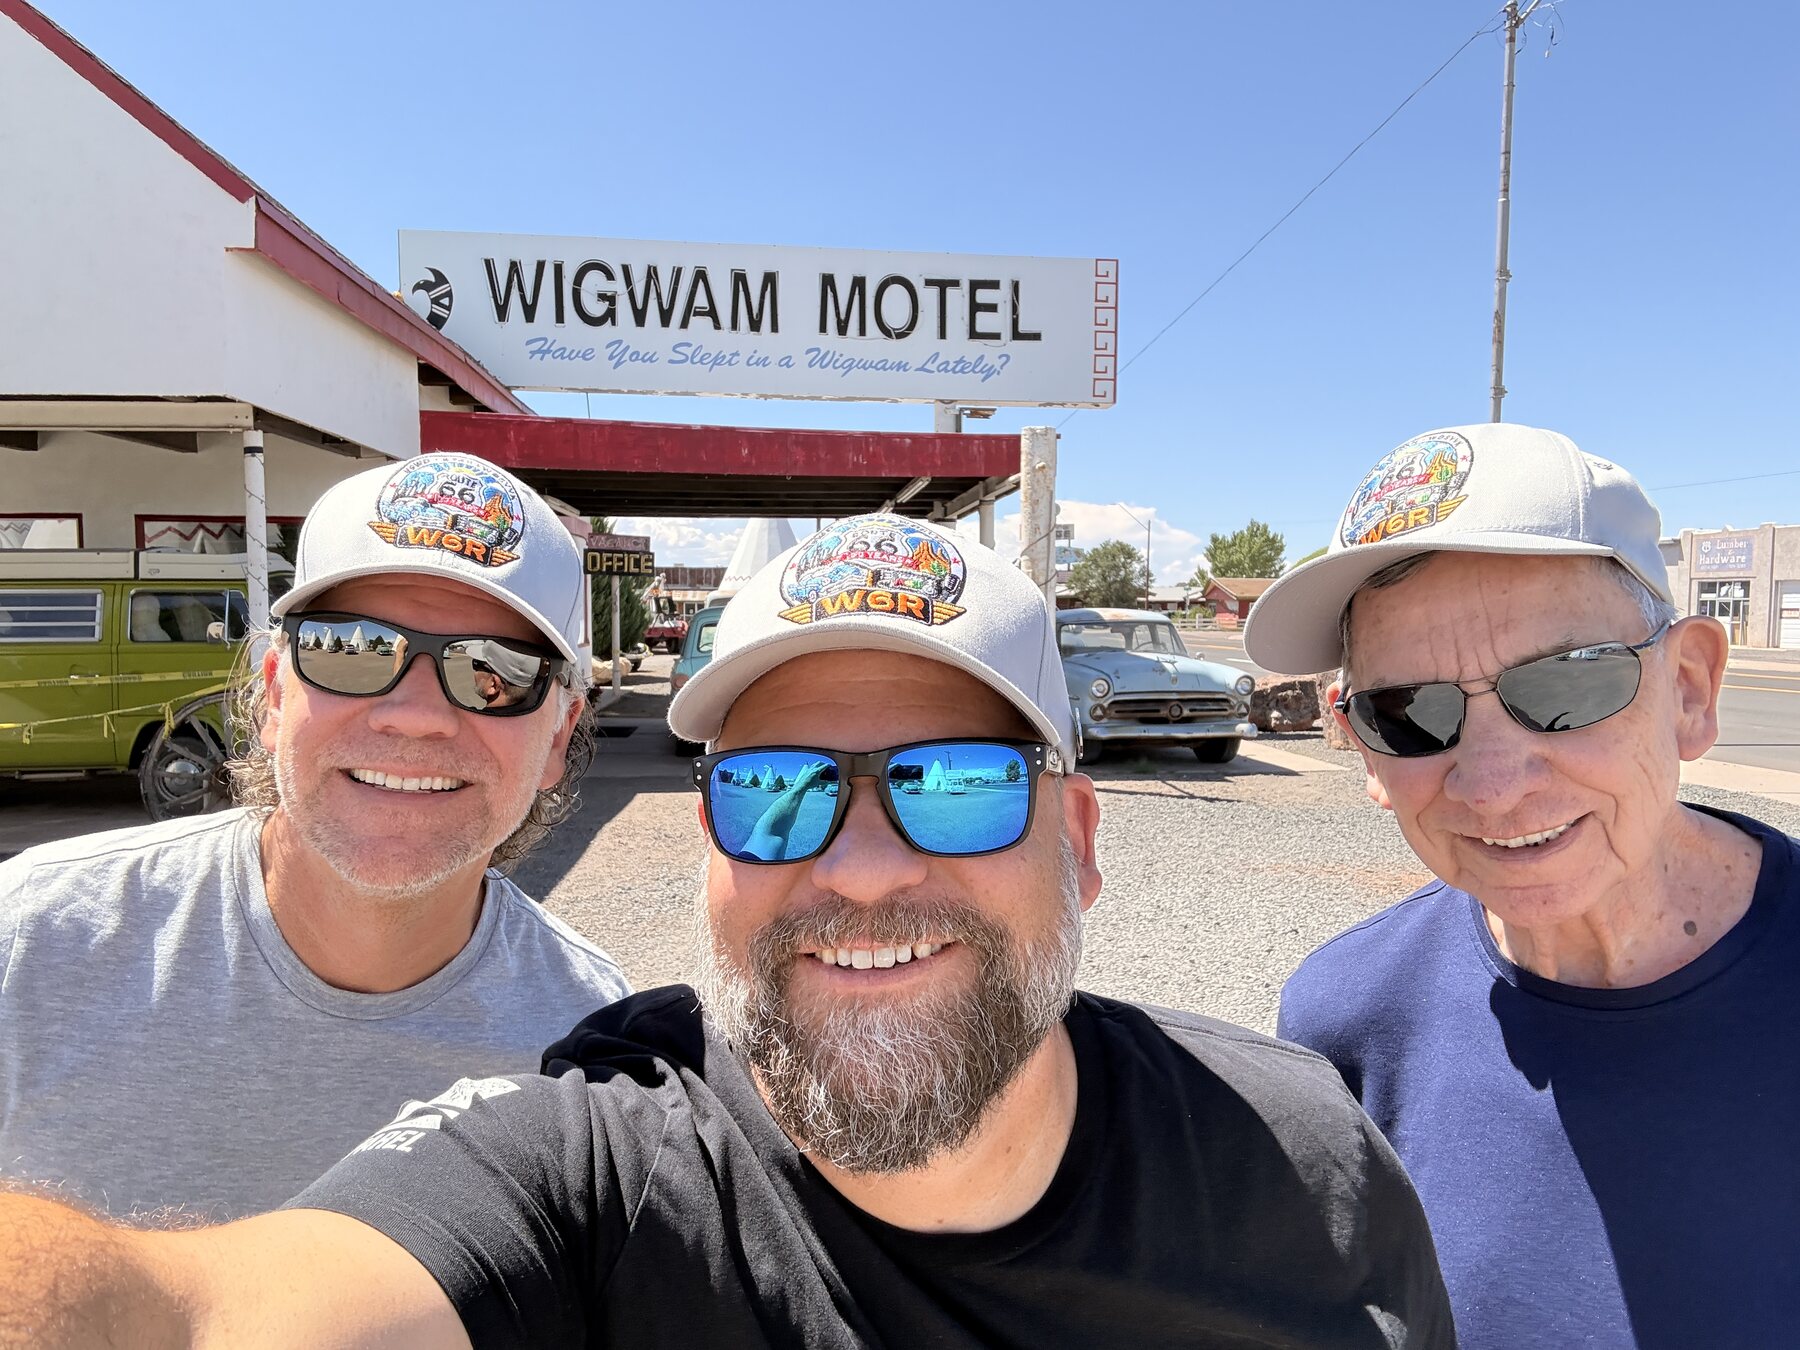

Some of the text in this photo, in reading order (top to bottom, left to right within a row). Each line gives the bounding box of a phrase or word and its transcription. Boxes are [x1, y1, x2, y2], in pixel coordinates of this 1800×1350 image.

[482, 257, 1043, 342] WIGWAM MOTEL
[525, 336, 1011, 383] Have You Slept in a Wigwam Lately?
[440, 481, 476, 505] 66
[590, 535, 647, 550] VACANCY
[850, 540, 898, 555] 66
[1716, 540, 1748, 549] Lumber
[587, 551, 653, 574] OFFICE
[1699, 553, 1746, 565] Hardware
